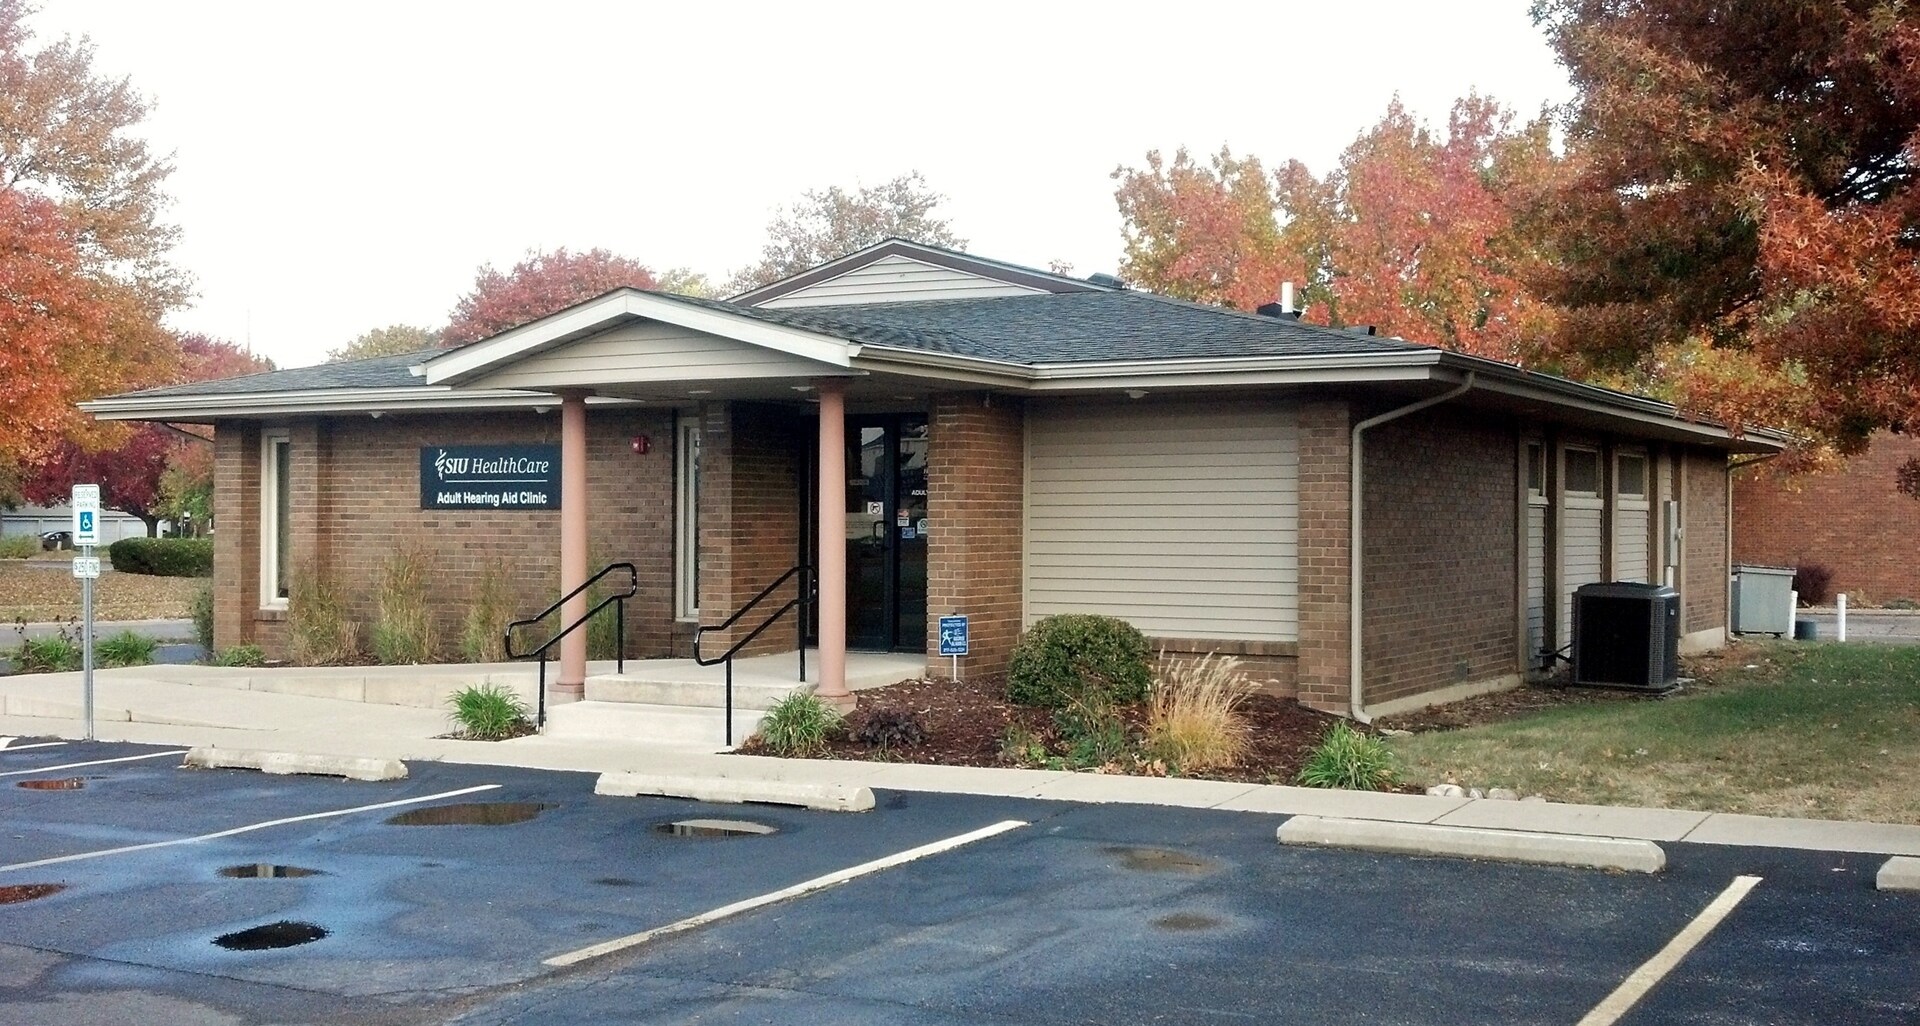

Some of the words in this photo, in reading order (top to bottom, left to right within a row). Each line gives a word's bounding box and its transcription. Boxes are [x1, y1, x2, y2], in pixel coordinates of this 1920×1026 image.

[444, 458, 469, 474] SIU
[471, 457, 549, 474] HealthCare
[436, 491, 462, 504] Adult
[463, 491, 500, 507] Hearing
[501, 491, 518, 504] Aid
[519, 491, 548, 504] Clinic
